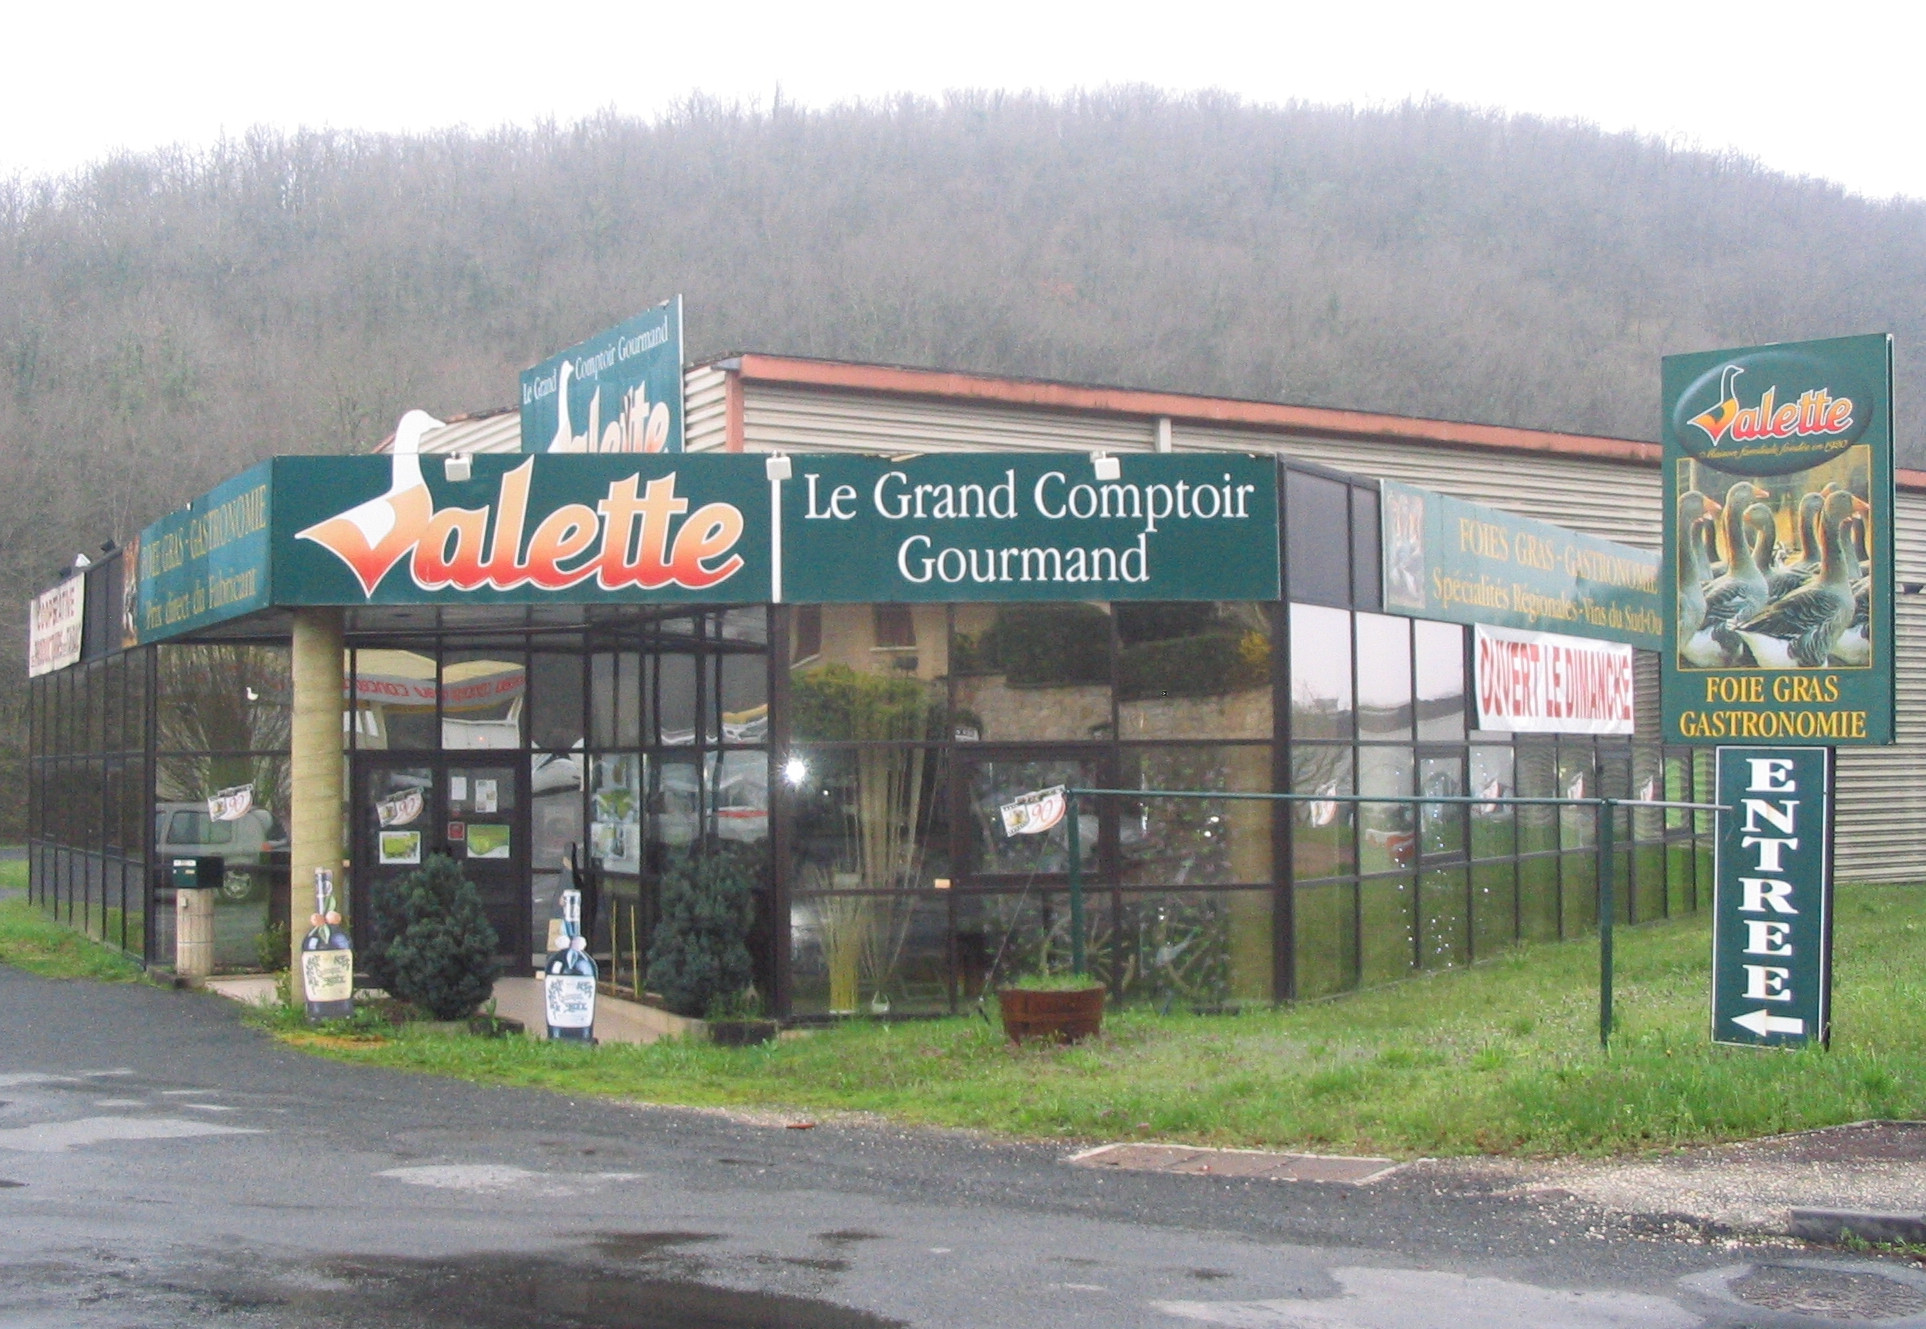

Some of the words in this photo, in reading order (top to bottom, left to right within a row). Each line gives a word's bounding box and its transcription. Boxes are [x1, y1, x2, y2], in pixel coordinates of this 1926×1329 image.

[534, 369, 557, 399] Grand
[575, 345, 616, 380] Comptoir
[618, 315, 668, 360] Gourmand
[1687, 366, 1854, 446] Valette
[294, 410, 745, 599] Valette
[804, 474, 857, 519] Le
[874, 469, 1018, 519] Grand
[1033, 471, 1255, 532] Comptoir
[897, 533, 1149, 583] Gourmand
[1459, 517, 1509, 562] FOIES
[1515, 531, 1554, 571] GRAS
[1432, 566, 1510, 610] Spécialités
[1480, 637, 1541, 717] OUVERT
[1544, 645, 1562, 718] LE
[1565, 648, 1631, 720] DIMANCHE
[1705, 676, 1764, 702] FOIE
[1773, 675, 1839, 702] GRAS
[1679, 710, 1867, 739] GASTRONOMIE
[1738, 758, 1800, 1002] ENTREE
